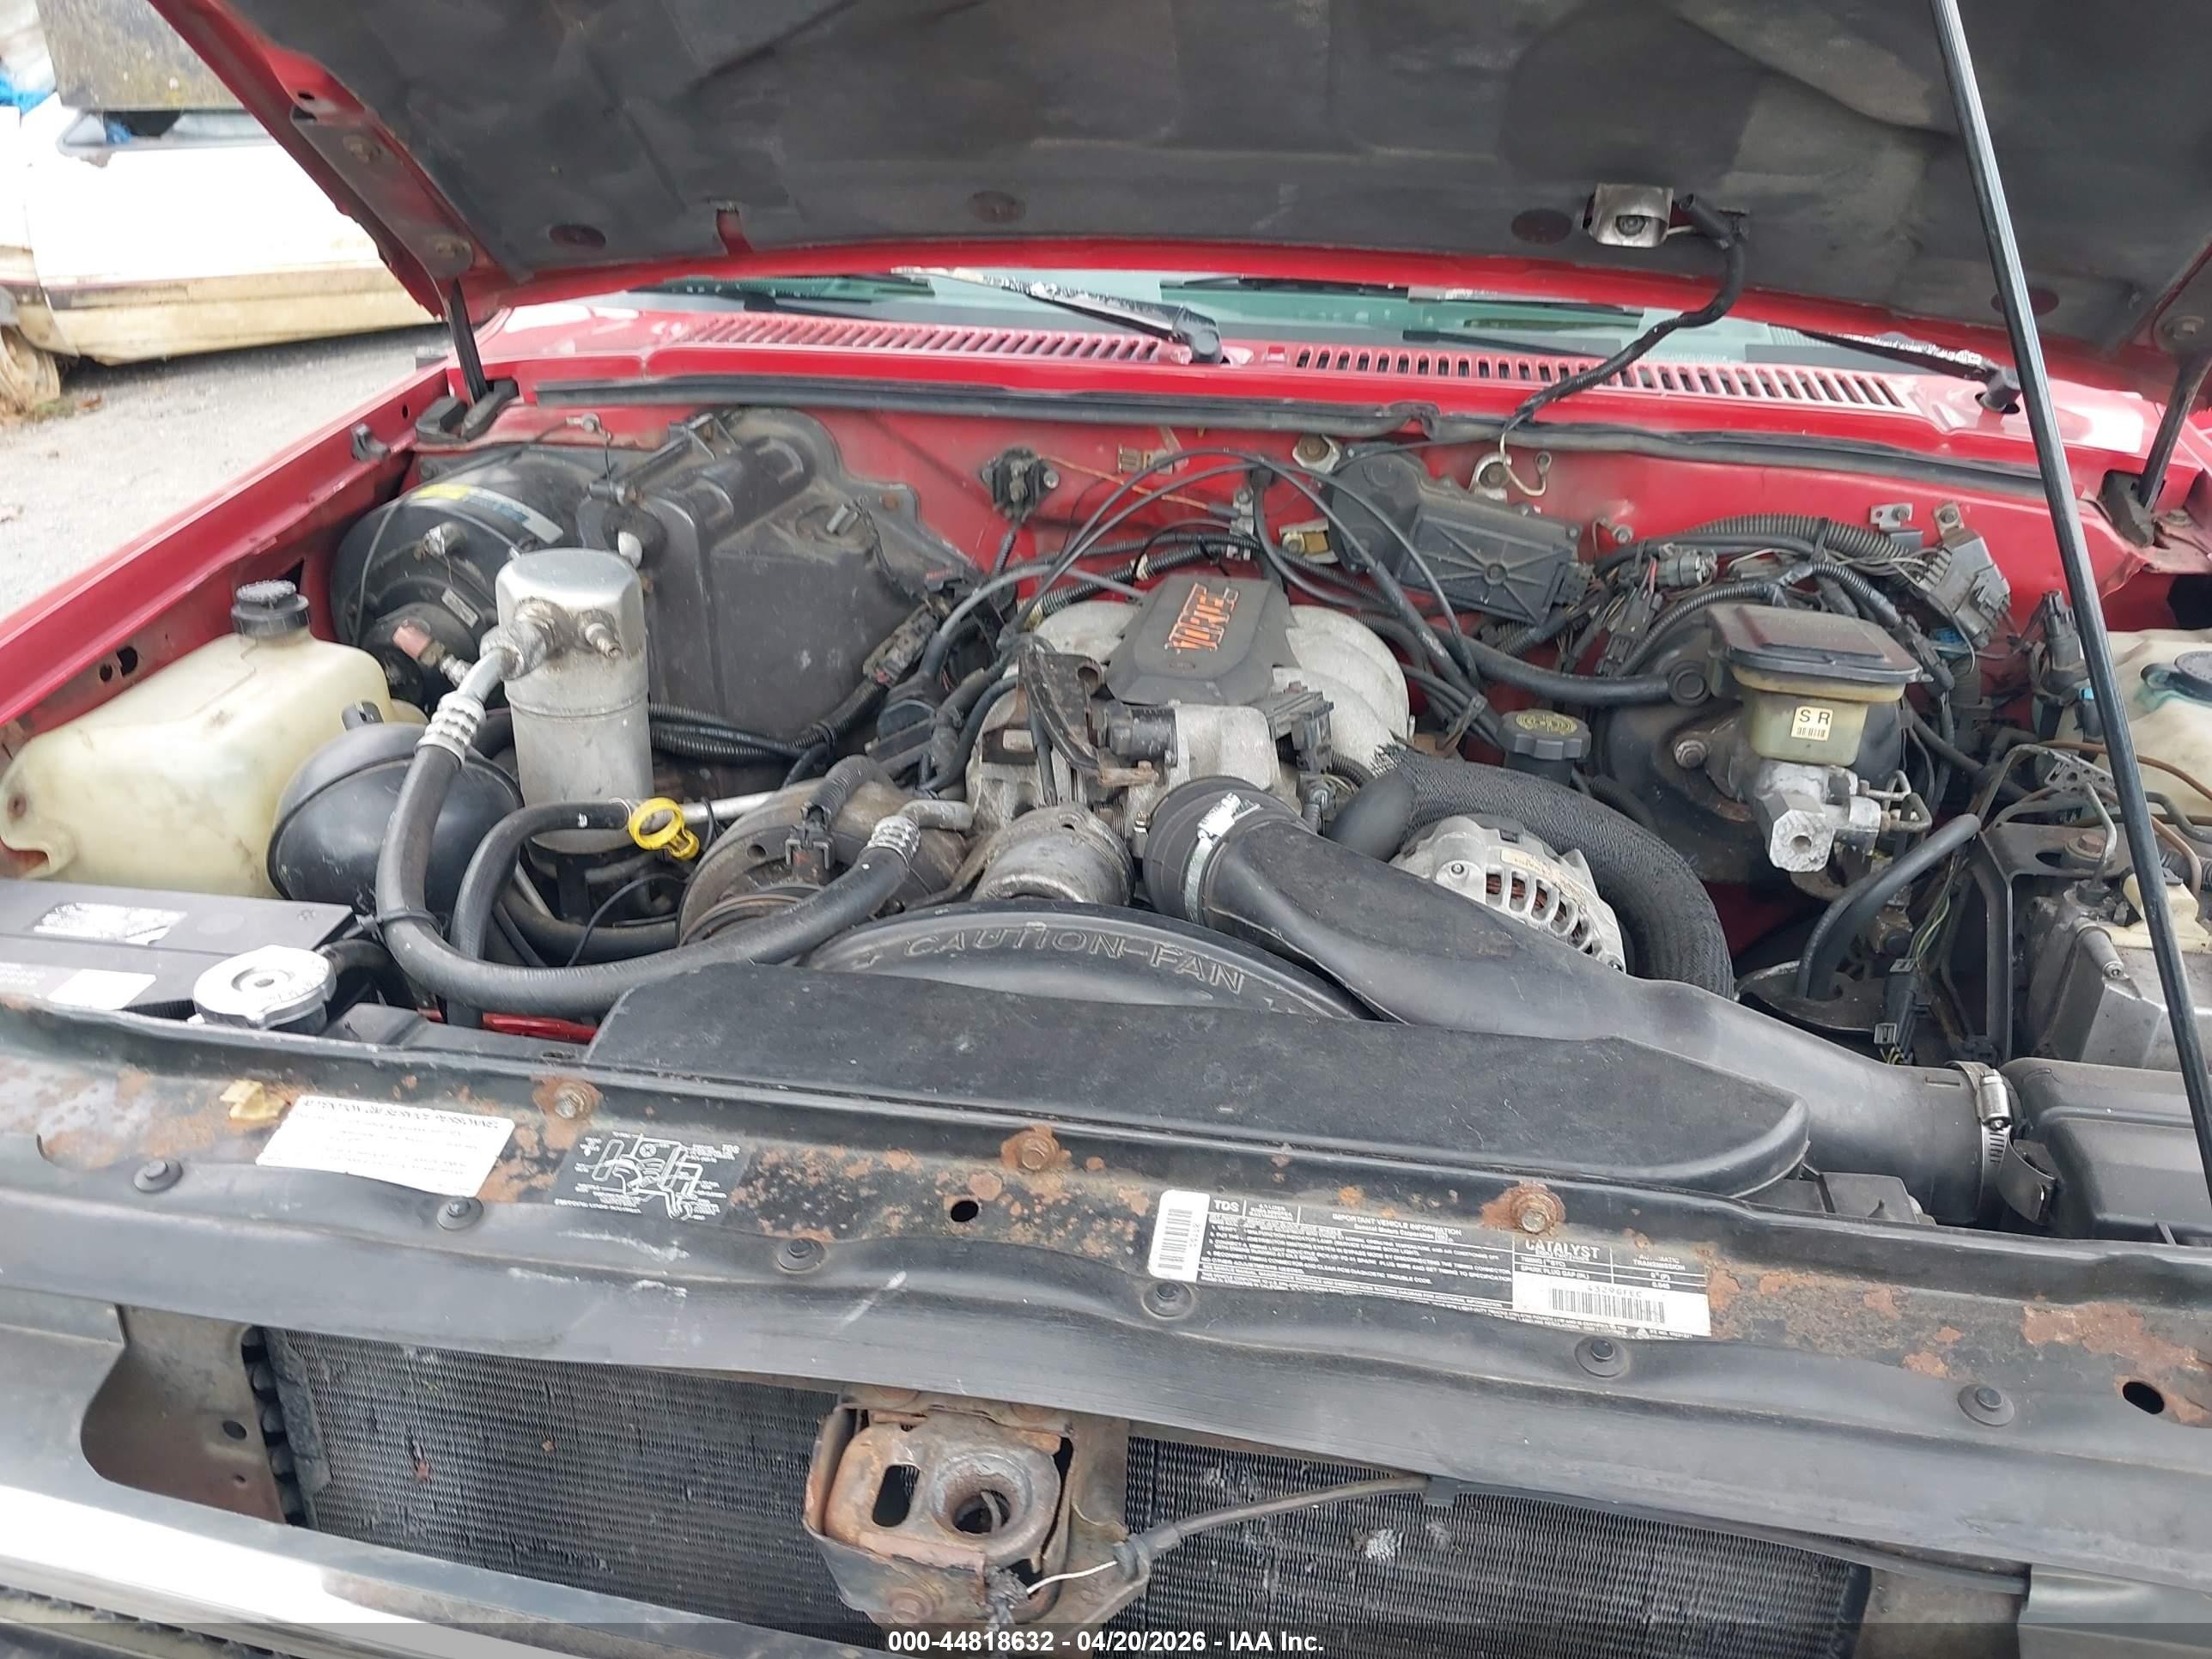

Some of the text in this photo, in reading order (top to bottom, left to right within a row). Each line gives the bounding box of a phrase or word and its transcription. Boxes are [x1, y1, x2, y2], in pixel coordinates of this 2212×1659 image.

[1213, 1200, 1239, 1212] TDS
[1332, 1212, 1462, 1236] IMPORTANT VEHICLE INFORMATION
[1525, 1238, 1601, 1259] CATALYST
